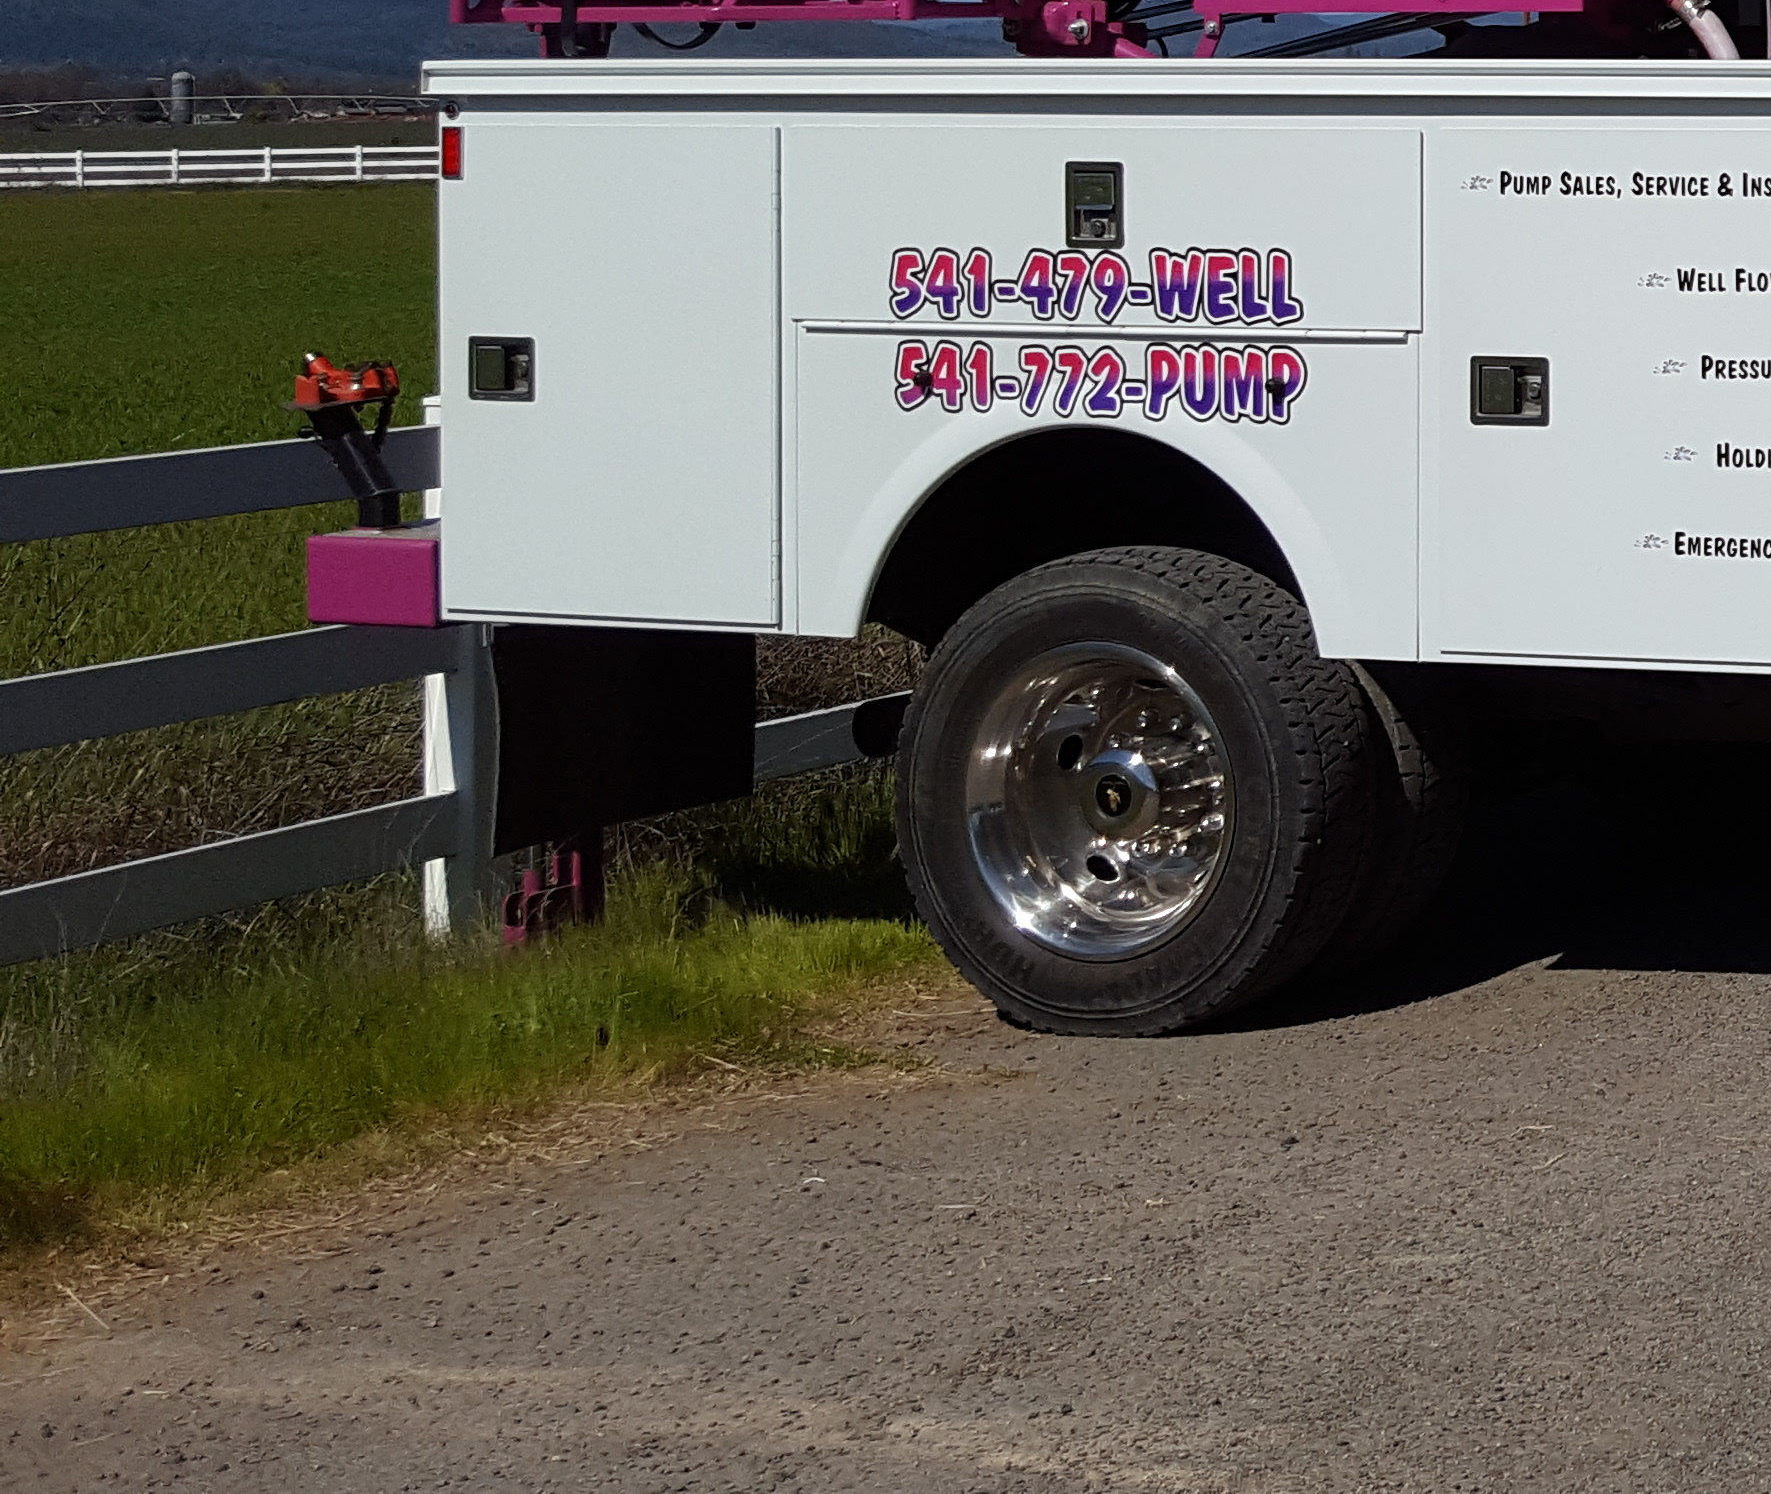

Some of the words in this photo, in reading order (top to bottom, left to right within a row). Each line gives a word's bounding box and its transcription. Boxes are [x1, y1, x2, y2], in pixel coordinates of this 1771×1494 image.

[1717, 173, 1734, 198] &
[888, 246, 1305, 324] 541-479-WELL
[894, 338, 1309, 425] 541-772-PUMP
